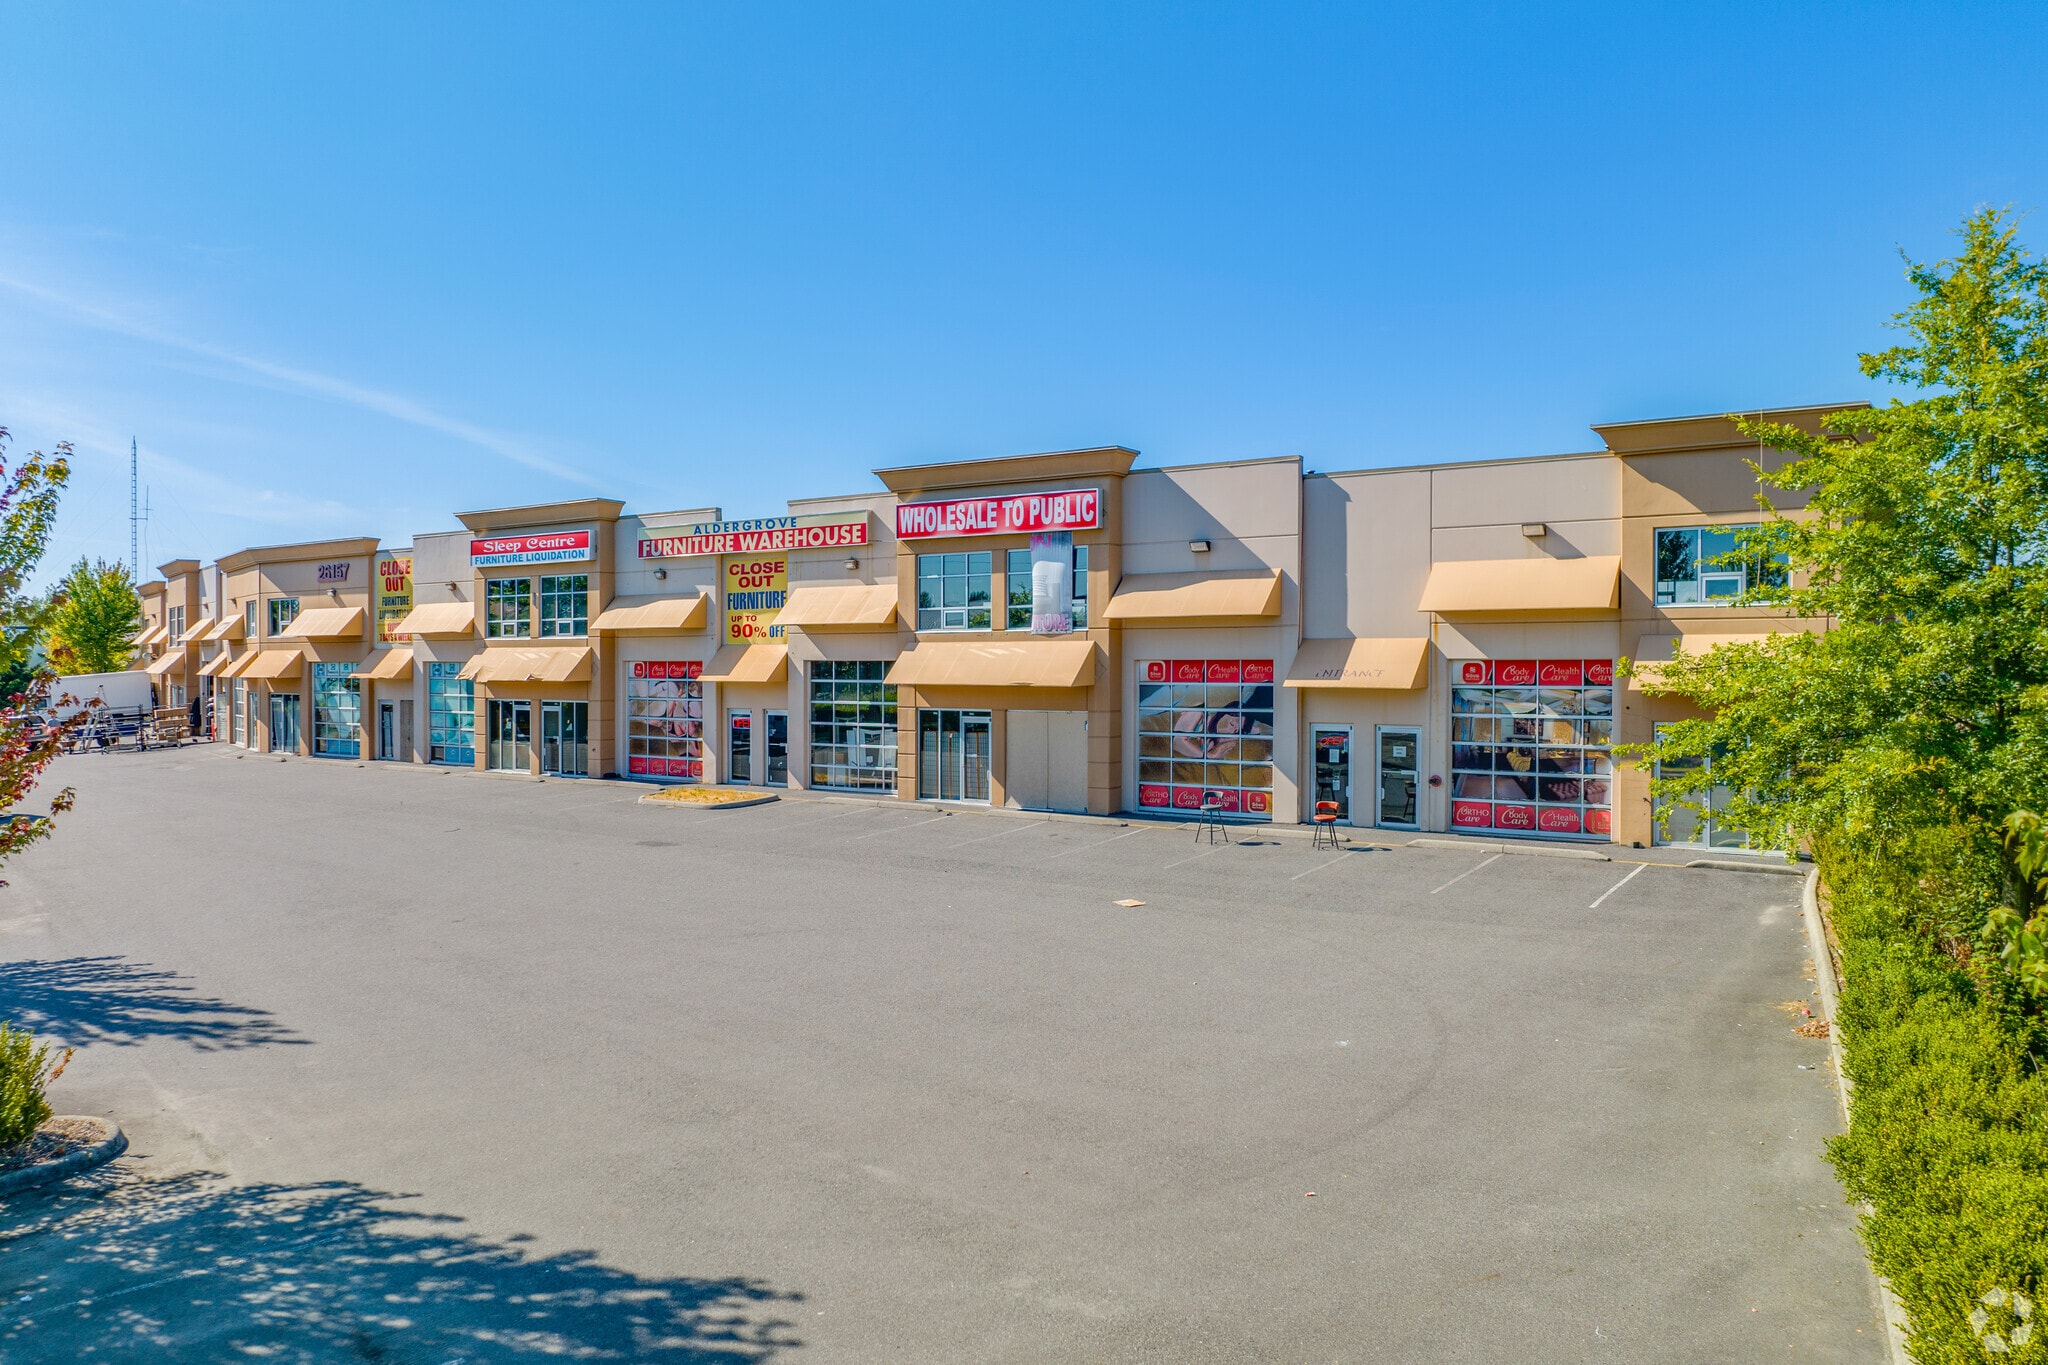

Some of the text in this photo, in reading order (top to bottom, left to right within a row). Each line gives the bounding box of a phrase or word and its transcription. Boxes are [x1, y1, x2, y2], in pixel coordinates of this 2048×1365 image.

[900, 494, 1095, 534] WHOLESALE TO PUBLIC
[693, 517, 797, 535] ALDERGROVE
[483, 537, 575, 552] Sleep Centre
[642, 525, 862, 557] FURNITURE WAREHOUSE
[474, 549, 585, 565] FURNITURE LIQUIDATION
[380, 560, 411, 576] CLOSE
[729, 561, 785, 576] CLOSE
[385, 576, 405, 592] OUT
[738, 575, 774, 588] OUT
[382, 596, 409, 606] FURNITURE
[728, 591, 787, 610] FURNITURE
[731, 624, 785, 638] 90% OFF
[1510, 668, 1529, 677] Body
[1554, 667, 1580, 675] Health
[1456, 805, 1480, 822] Care
[1460, 808, 1489, 817] ORTHO
[1502, 808, 1529, 825] Care
[1509, 809, 1528, 819] Body
[1553, 813, 1579, 821] Health
